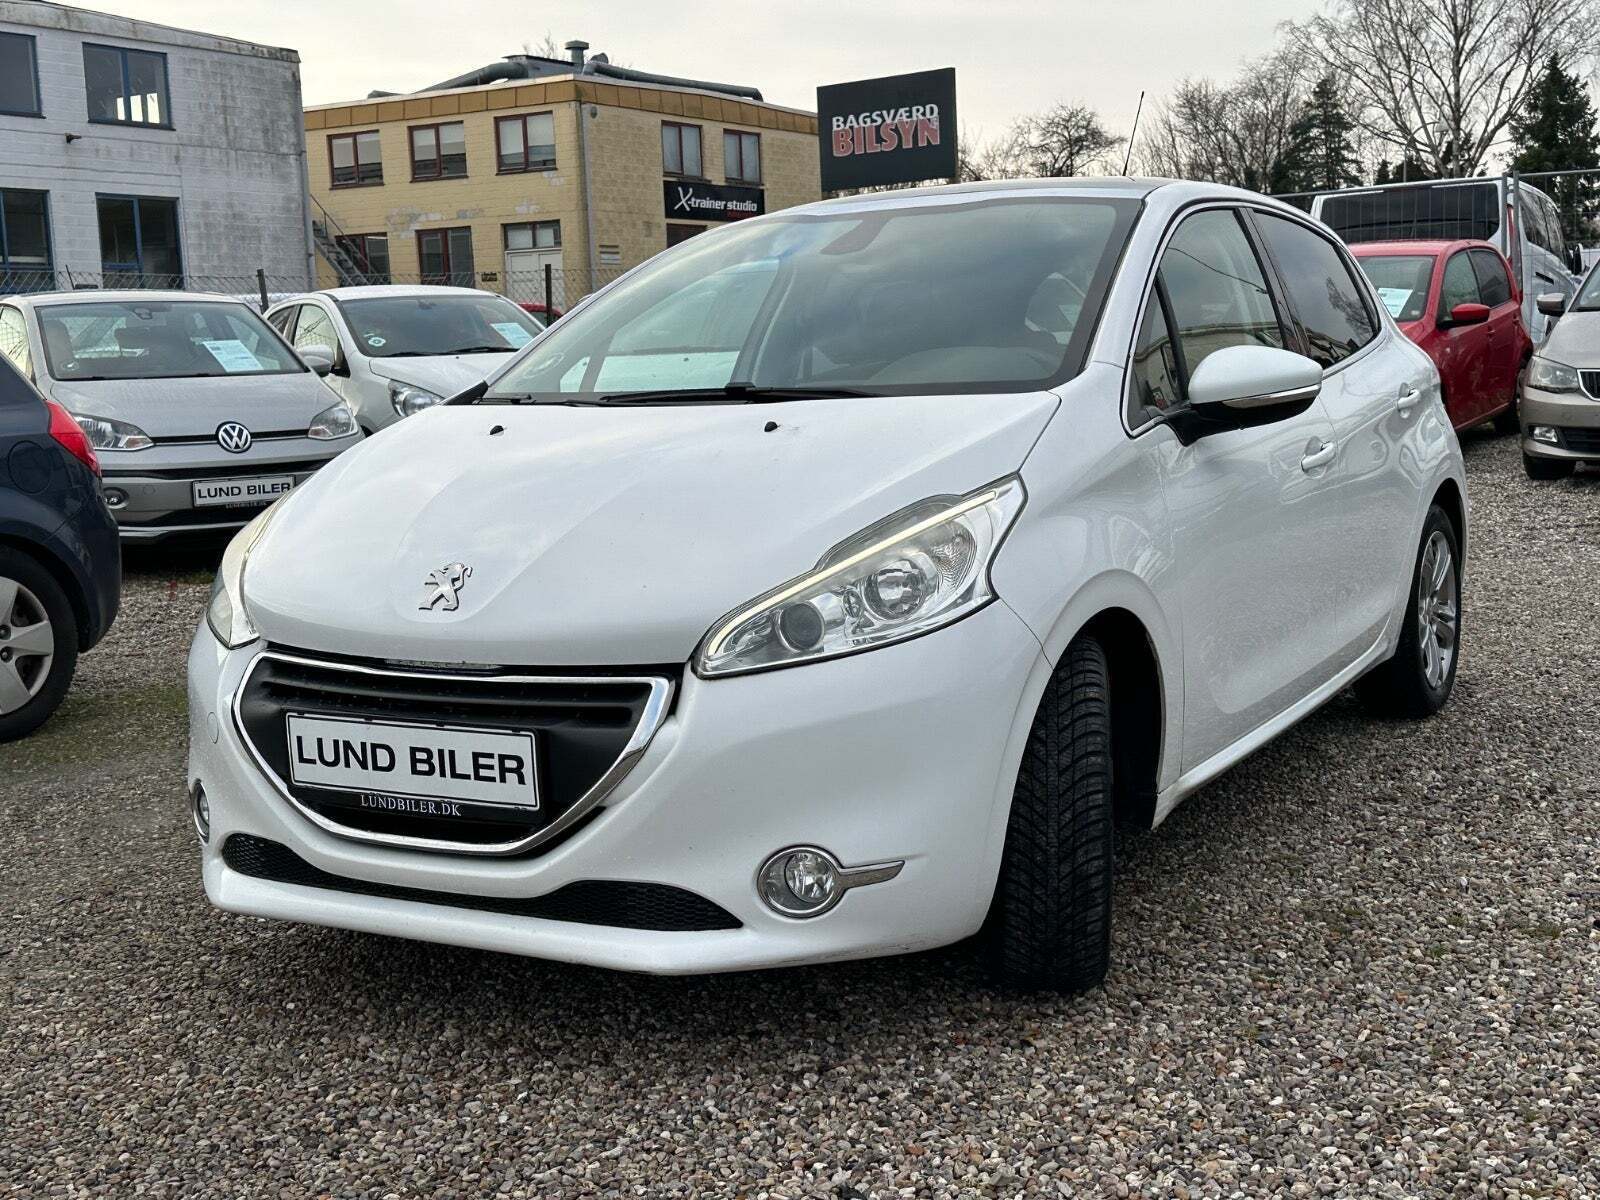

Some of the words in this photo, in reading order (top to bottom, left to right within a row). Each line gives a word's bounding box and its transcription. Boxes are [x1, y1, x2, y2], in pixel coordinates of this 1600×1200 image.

[832, 104, 939, 130] BAGSVÆRD
[832, 118, 940, 157] BILSYN
[674, 187, 726, 211] X-trainer
[726, 200, 758, 211] studio
[198, 486, 241, 498] LUND
[247, 483, 291, 495] BILER
[296, 736, 396, 772] LUND
[409, 746, 526, 785] BILER
[361, 794, 461, 816] LUNDBILER.DK
